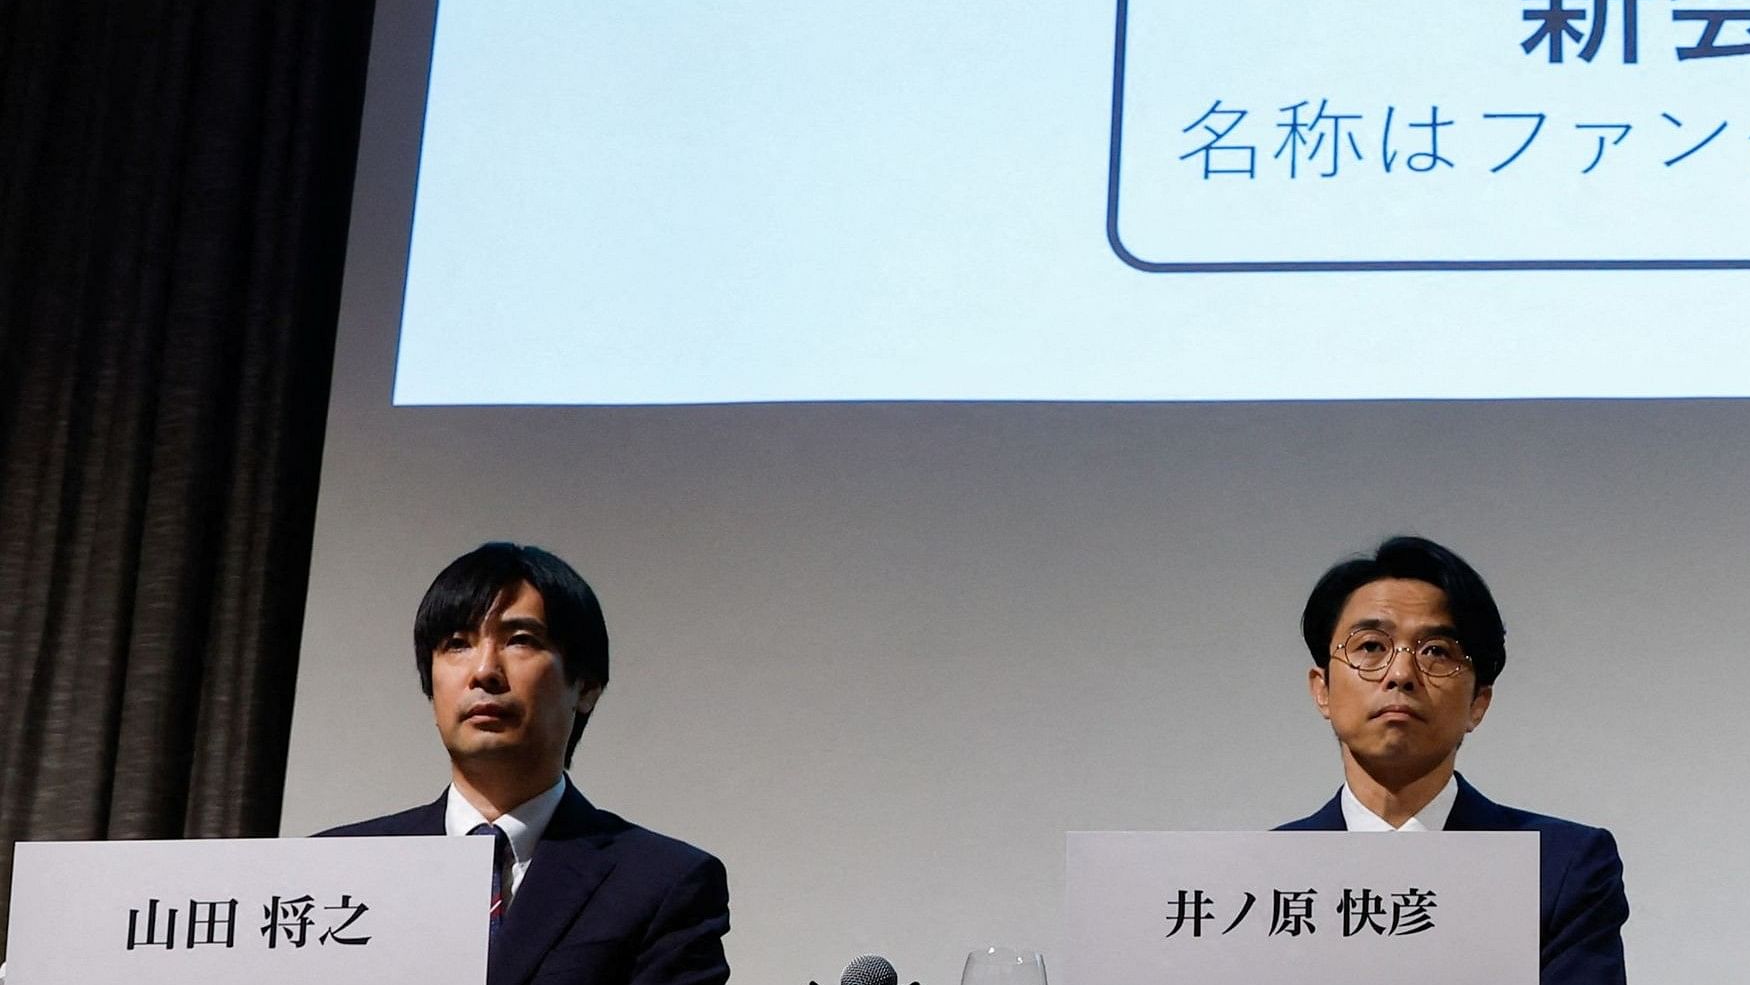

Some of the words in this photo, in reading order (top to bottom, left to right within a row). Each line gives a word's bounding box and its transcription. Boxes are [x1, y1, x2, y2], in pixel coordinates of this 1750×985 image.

[126, 897, 239, 951] 山田
[259, 894, 373, 950] 将之
[1165, 887, 1319, 939] 井ノ原
[1335, 887, 1438, 938] 快彦
